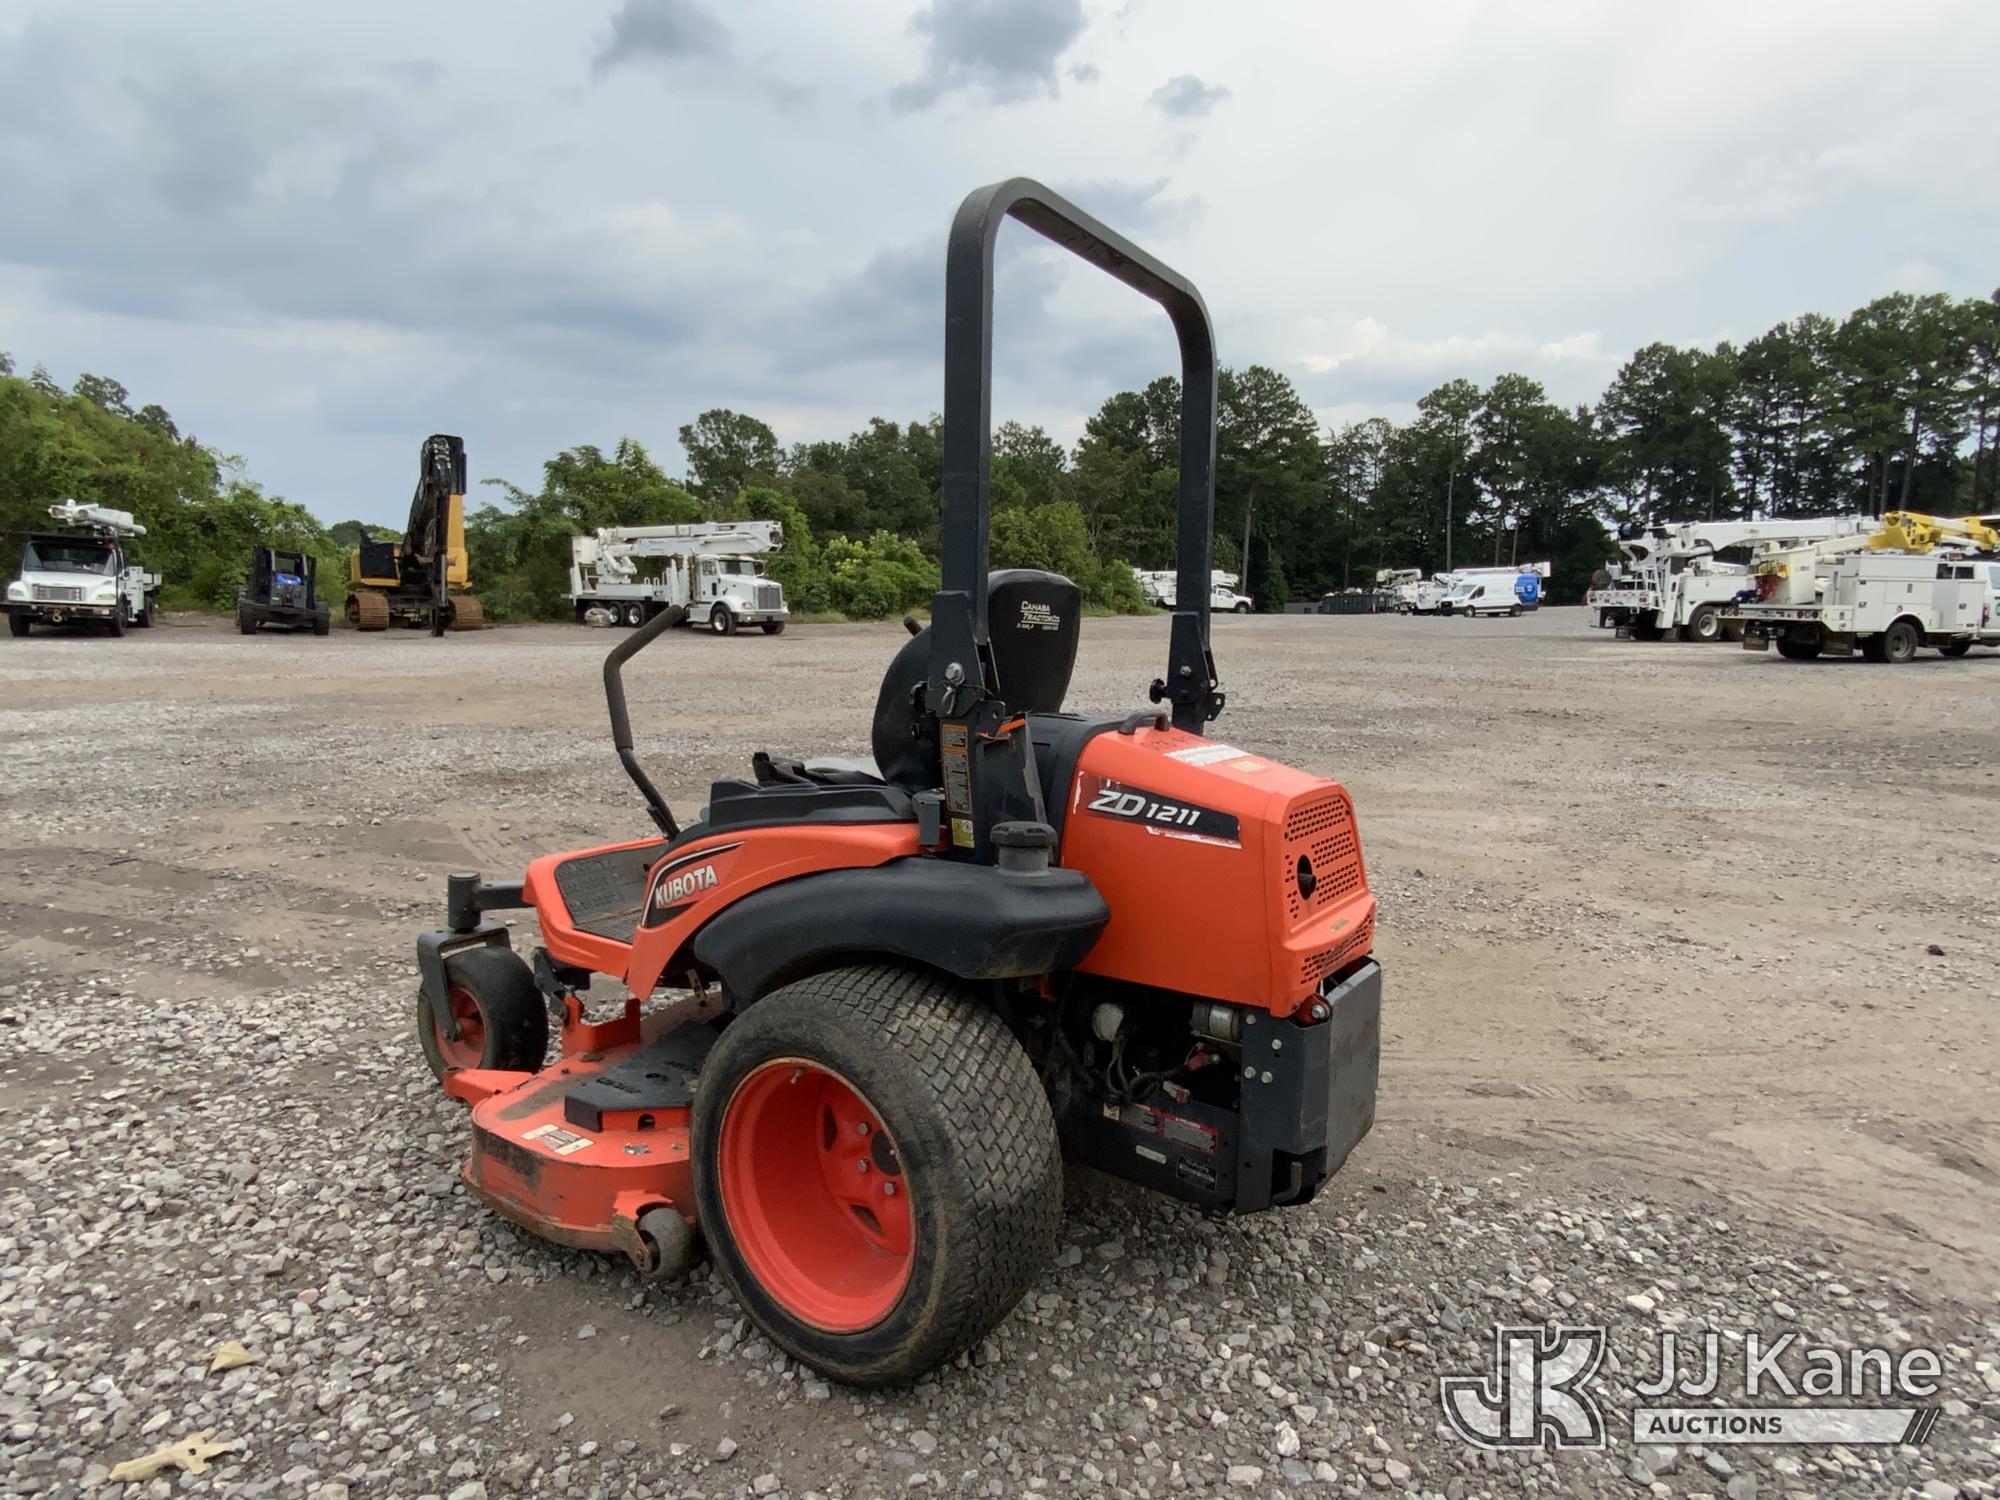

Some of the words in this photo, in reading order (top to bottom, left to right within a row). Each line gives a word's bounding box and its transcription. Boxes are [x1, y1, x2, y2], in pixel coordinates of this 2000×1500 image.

[1087, 789, 1147, 817] ZD
[1146, 803, 1201, 826] 1211
[655, 864, 719, 908] KUBOTA
